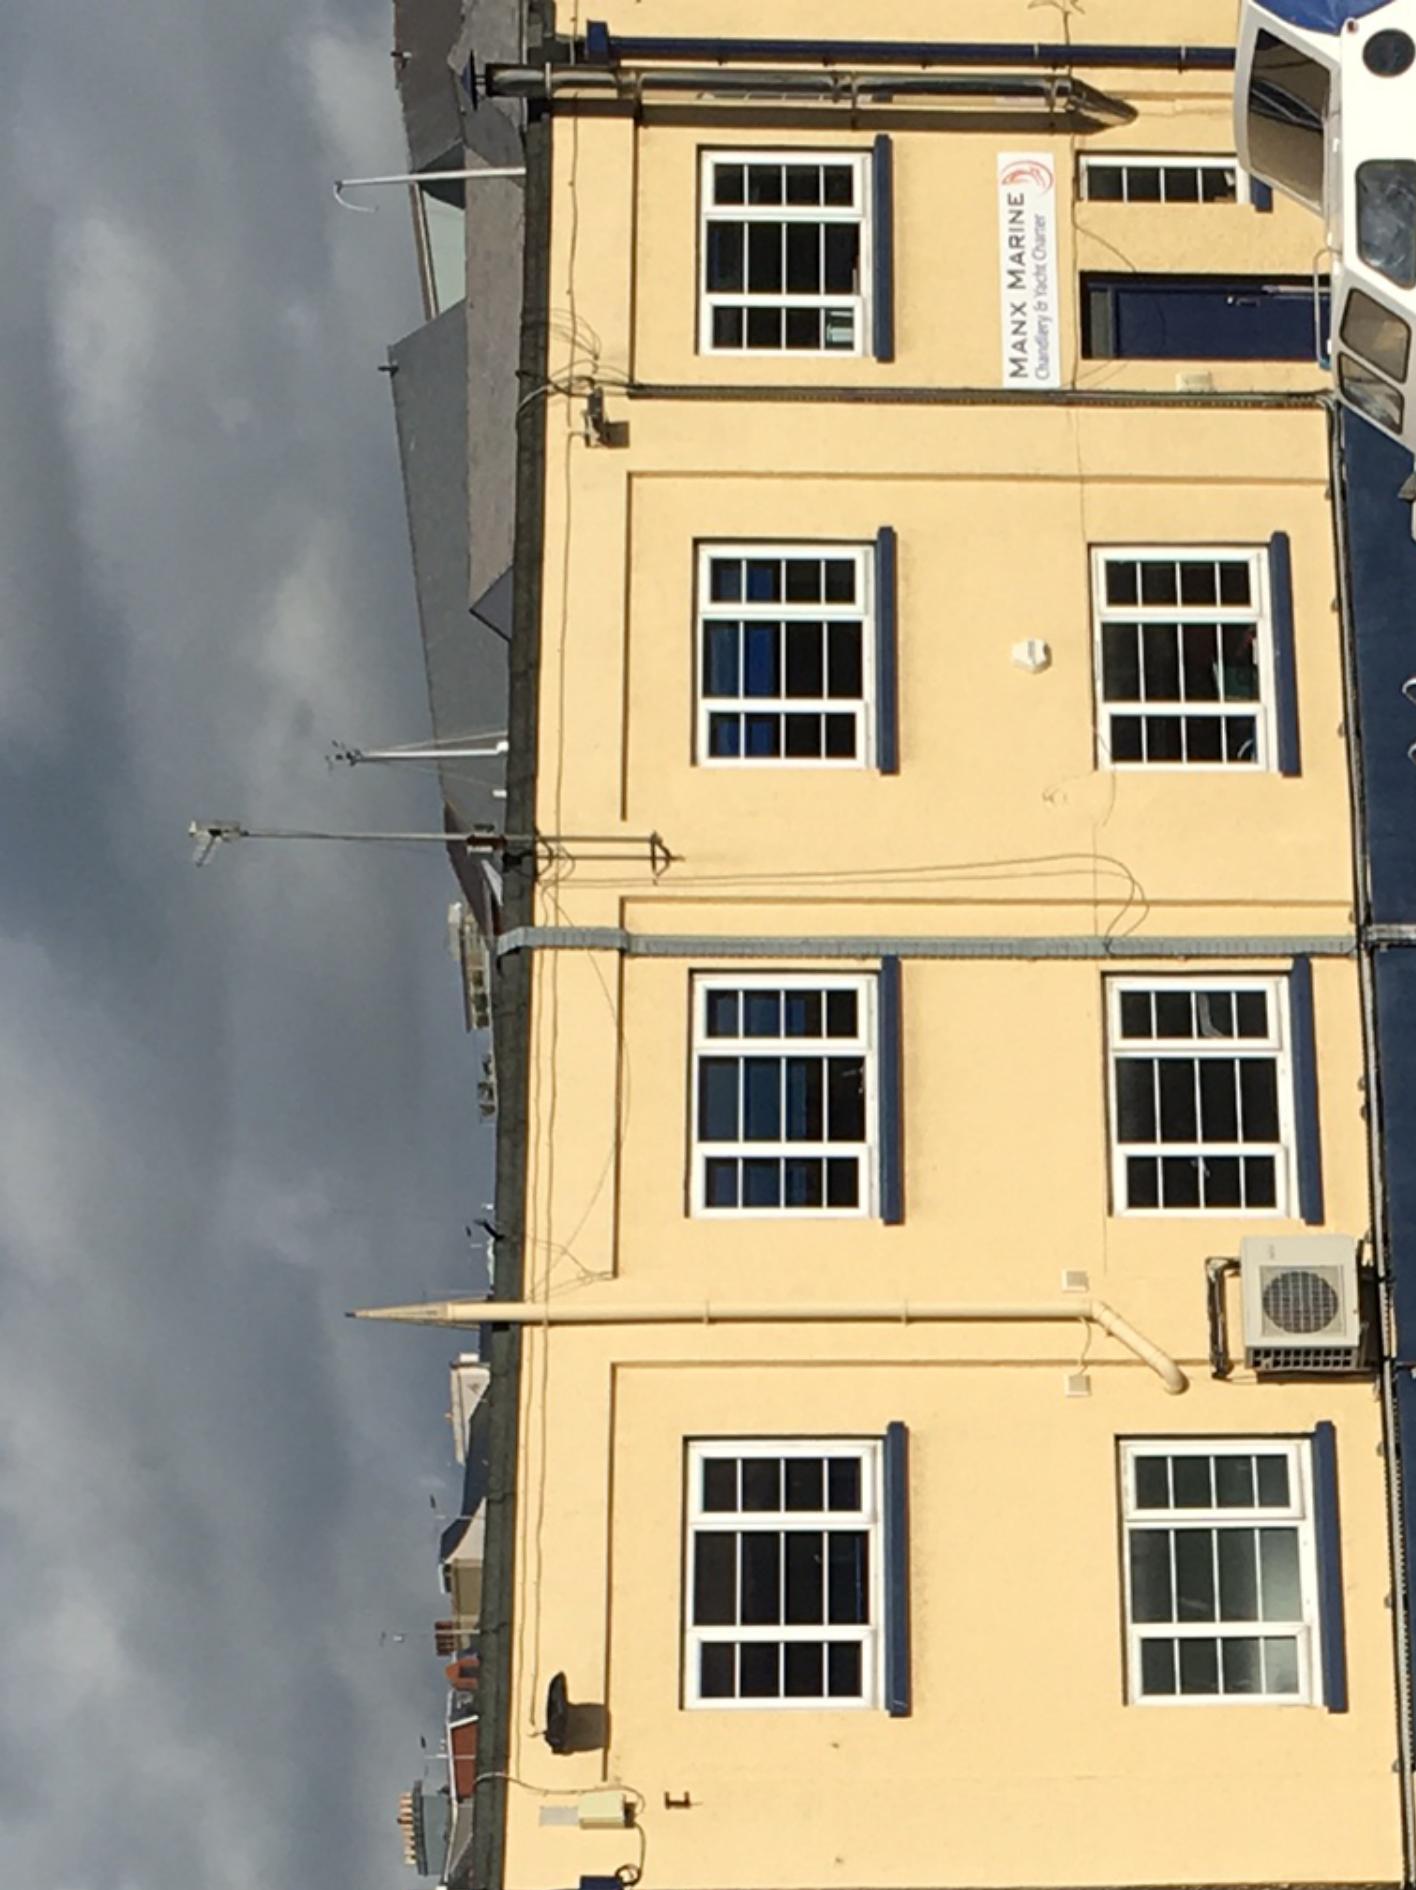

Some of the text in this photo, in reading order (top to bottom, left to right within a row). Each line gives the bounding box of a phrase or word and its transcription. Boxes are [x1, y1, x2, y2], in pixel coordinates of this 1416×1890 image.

[1006, 192, 1029, 378] MANX MARINE
[1031, 213, 1053, 381] Chandlery & Yacht Charter
